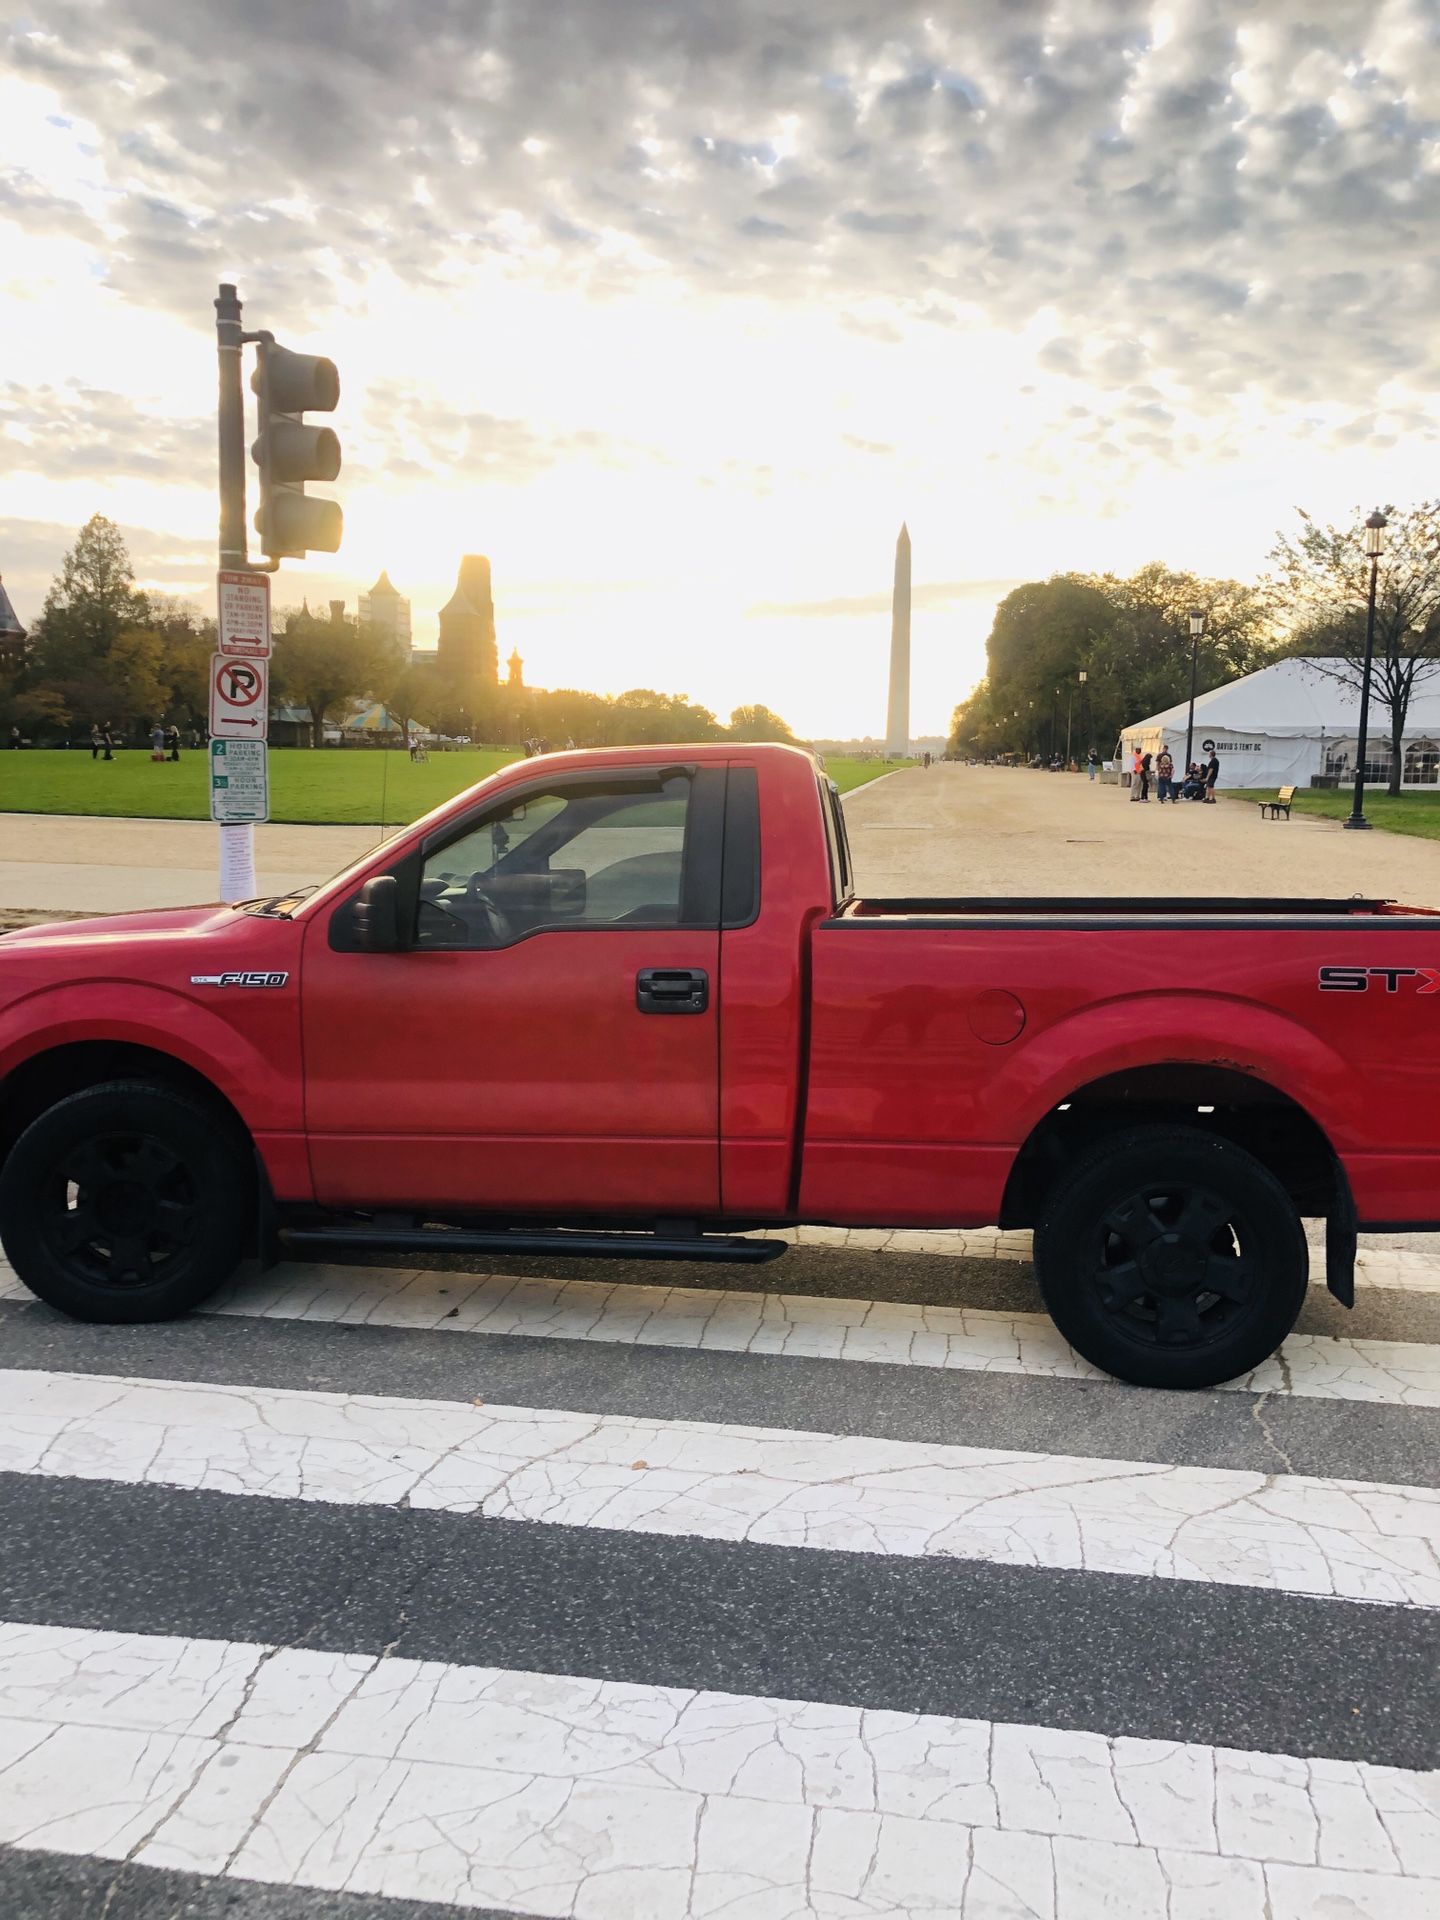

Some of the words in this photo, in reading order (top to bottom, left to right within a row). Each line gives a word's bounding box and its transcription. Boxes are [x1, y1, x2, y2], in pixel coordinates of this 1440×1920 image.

[226, 594, 262, 603] STANDING
[236, 604, 264, 612] PARKING
[216, 744, 224, 754] 2
[218, 972, 289, 988] F-150
